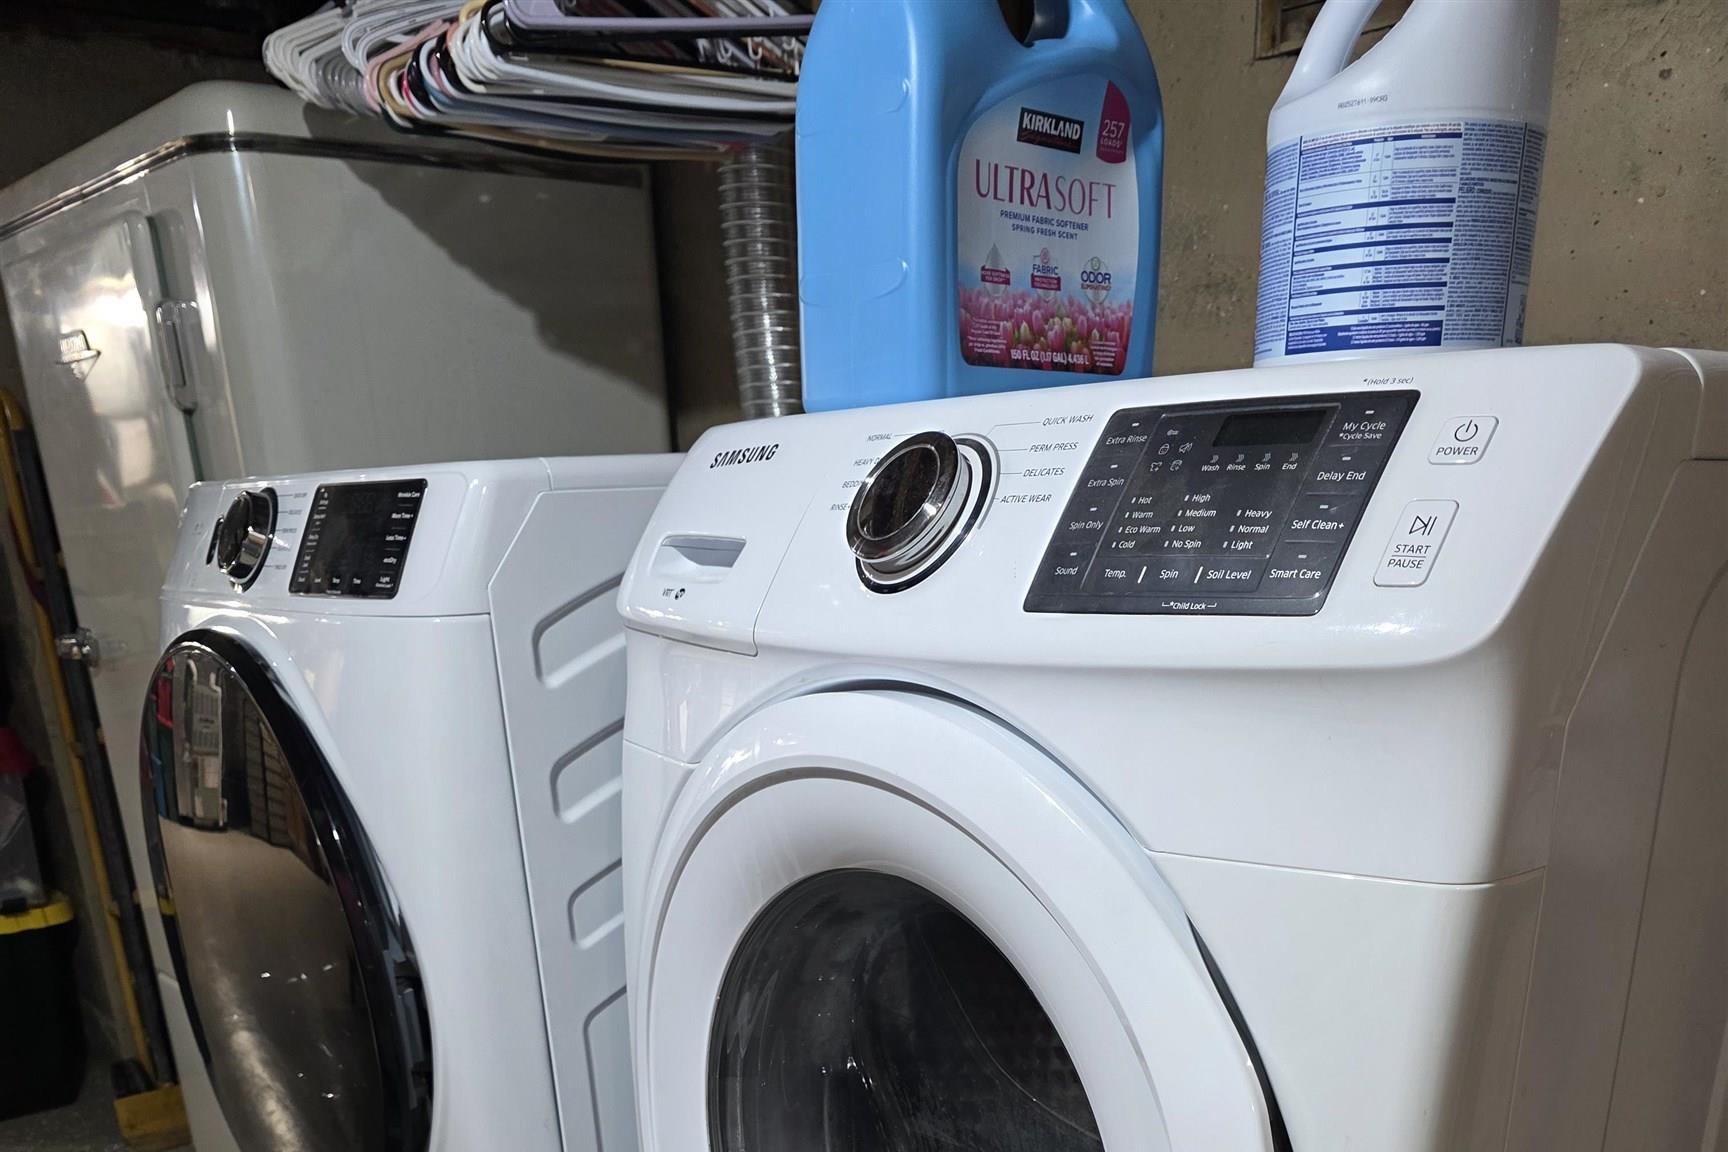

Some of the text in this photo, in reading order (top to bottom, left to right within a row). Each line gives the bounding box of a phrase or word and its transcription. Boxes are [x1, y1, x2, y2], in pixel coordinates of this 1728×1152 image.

[1022, 111, 1081, 141] KIRKLAND
[1102, 119, 1126, 139] 257
[975, 158, 1117, 219] ULTRASOFT
[1000, 209, 1089, 232] PREMIUM FABRIC SOFTENER
[1011, 223, 1078, 241] SPRING FRESH SCENT
[1032, 263, 1059, 276] FABRIC
[1081, 270, 1112, 284] ODOR
[1390, 377, 1396, 385] 3
[1398, 376, 1414, 385] sec)
[1042, 414, 1094, 426] QUICK WASH
[1342, 421, 1387, 431] My Cycle
[1106, 435, 1148, 445] Extra Rinse
[1029, 441, 1079, 453] PERM PRESS
[1435, 446, 1479, 456] POWER
[709, 443, 780, 469] SAMSUNG
[1201, 464, 1220, 472] Wash
[1226, 463, 1246, 471] Rinse
[1254, 463, 1271, 472] Spin
[1281, 462, 1298, 470] End
[1023, 467, 1066, 478] DELICATES
[1316, 471, 1367, 482] Delay End
[1087, 477, 1125, 488] Extra Spin
[1000, 493, 1052, 504] ACTIVE WEAR
[1138, 496, 1153, 504] Hot
[1191, 494, 1211, 503] High
[1132, 511, 1153, 519] Warm
[1185, 509, 1217, 518] Medium
[1244, 509, 1272, 519] Heavy
[1069, 520, 1104, 530] Spin Only
[1125, 525, 1138, 533] Eco
[1178, 525, 1195, 533] Low
[1238, 525, 1270, 533] Normal
[1291, 519, 1310, 530] Self
[1118, 540, 1136, 549] Cold
[1171, 540, 1202, 549] No Spin
[1231, 540, 1253, 550] Light
[1394, 543, 1432, 555] START
[1386, 558, 1424, 569] PAUSE
[1055, 566, 1079, 575] Sound
[1104, 568, 1127, 579] Temp.
[1159, 569, 1179, 579] Spin
[1206, 569, 1252, 580] Soil Level
[1269, 569, 1322, 579] Smart Care
[1190, 602, 1206, 610] Lock
